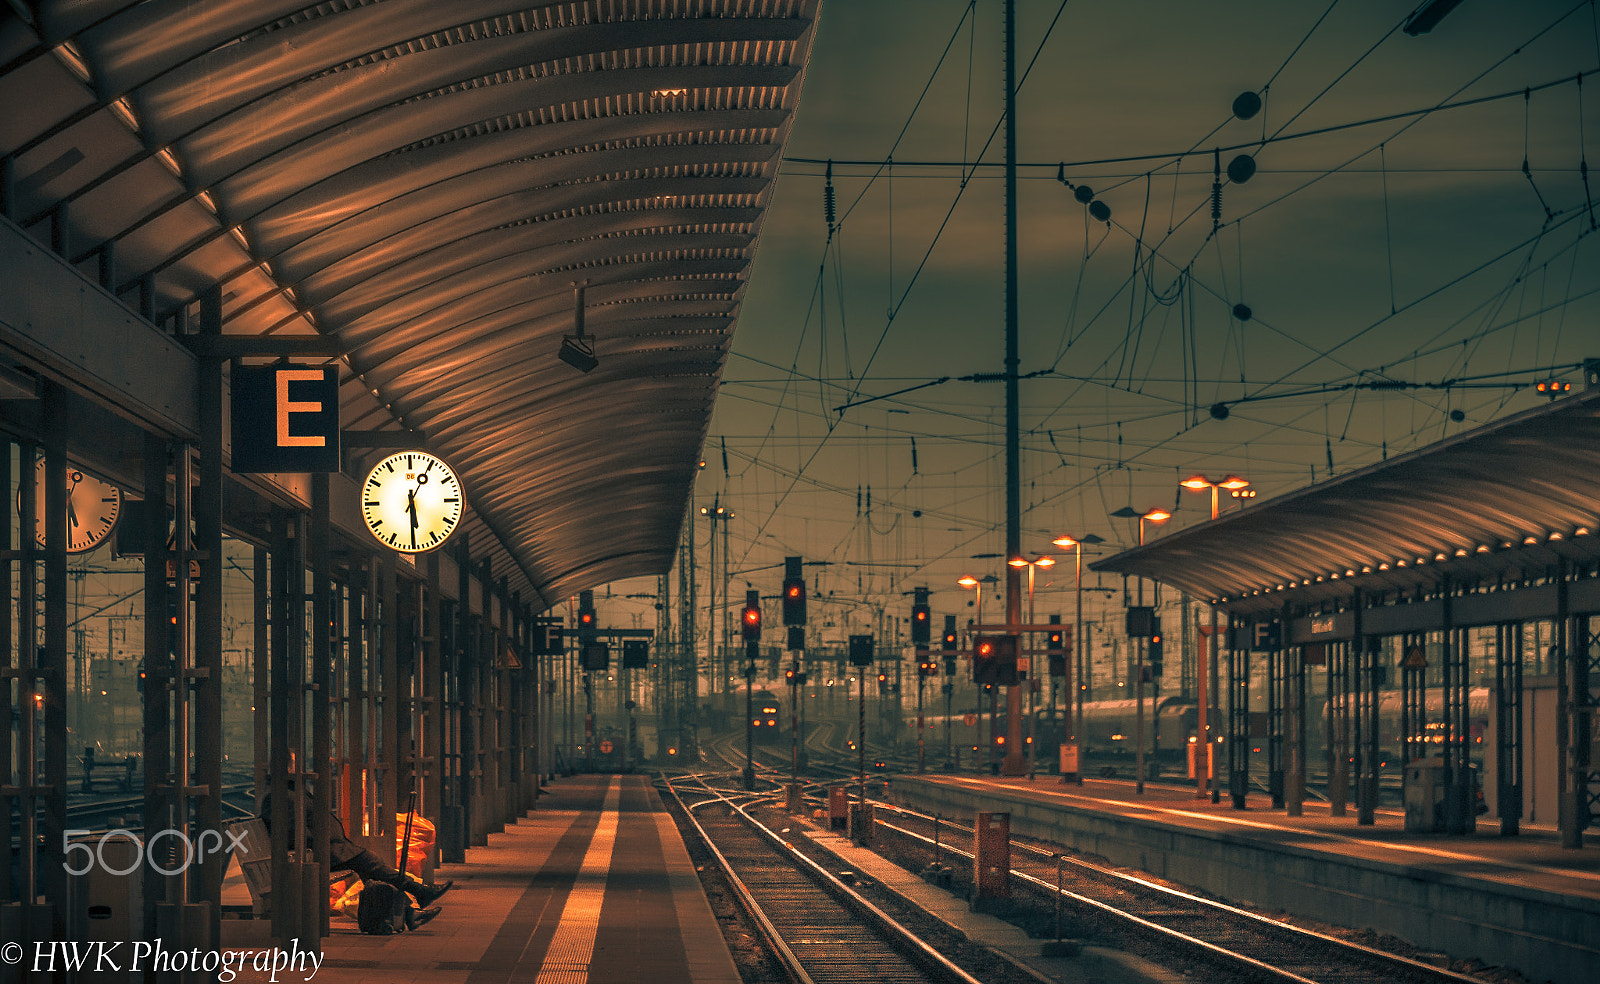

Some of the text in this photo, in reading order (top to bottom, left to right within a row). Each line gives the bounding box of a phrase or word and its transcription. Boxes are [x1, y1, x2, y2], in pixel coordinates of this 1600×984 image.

[276, 370, 325, 447] E
[546, 626, 560, 649] F
[1255, 623, 1269, 647] F
